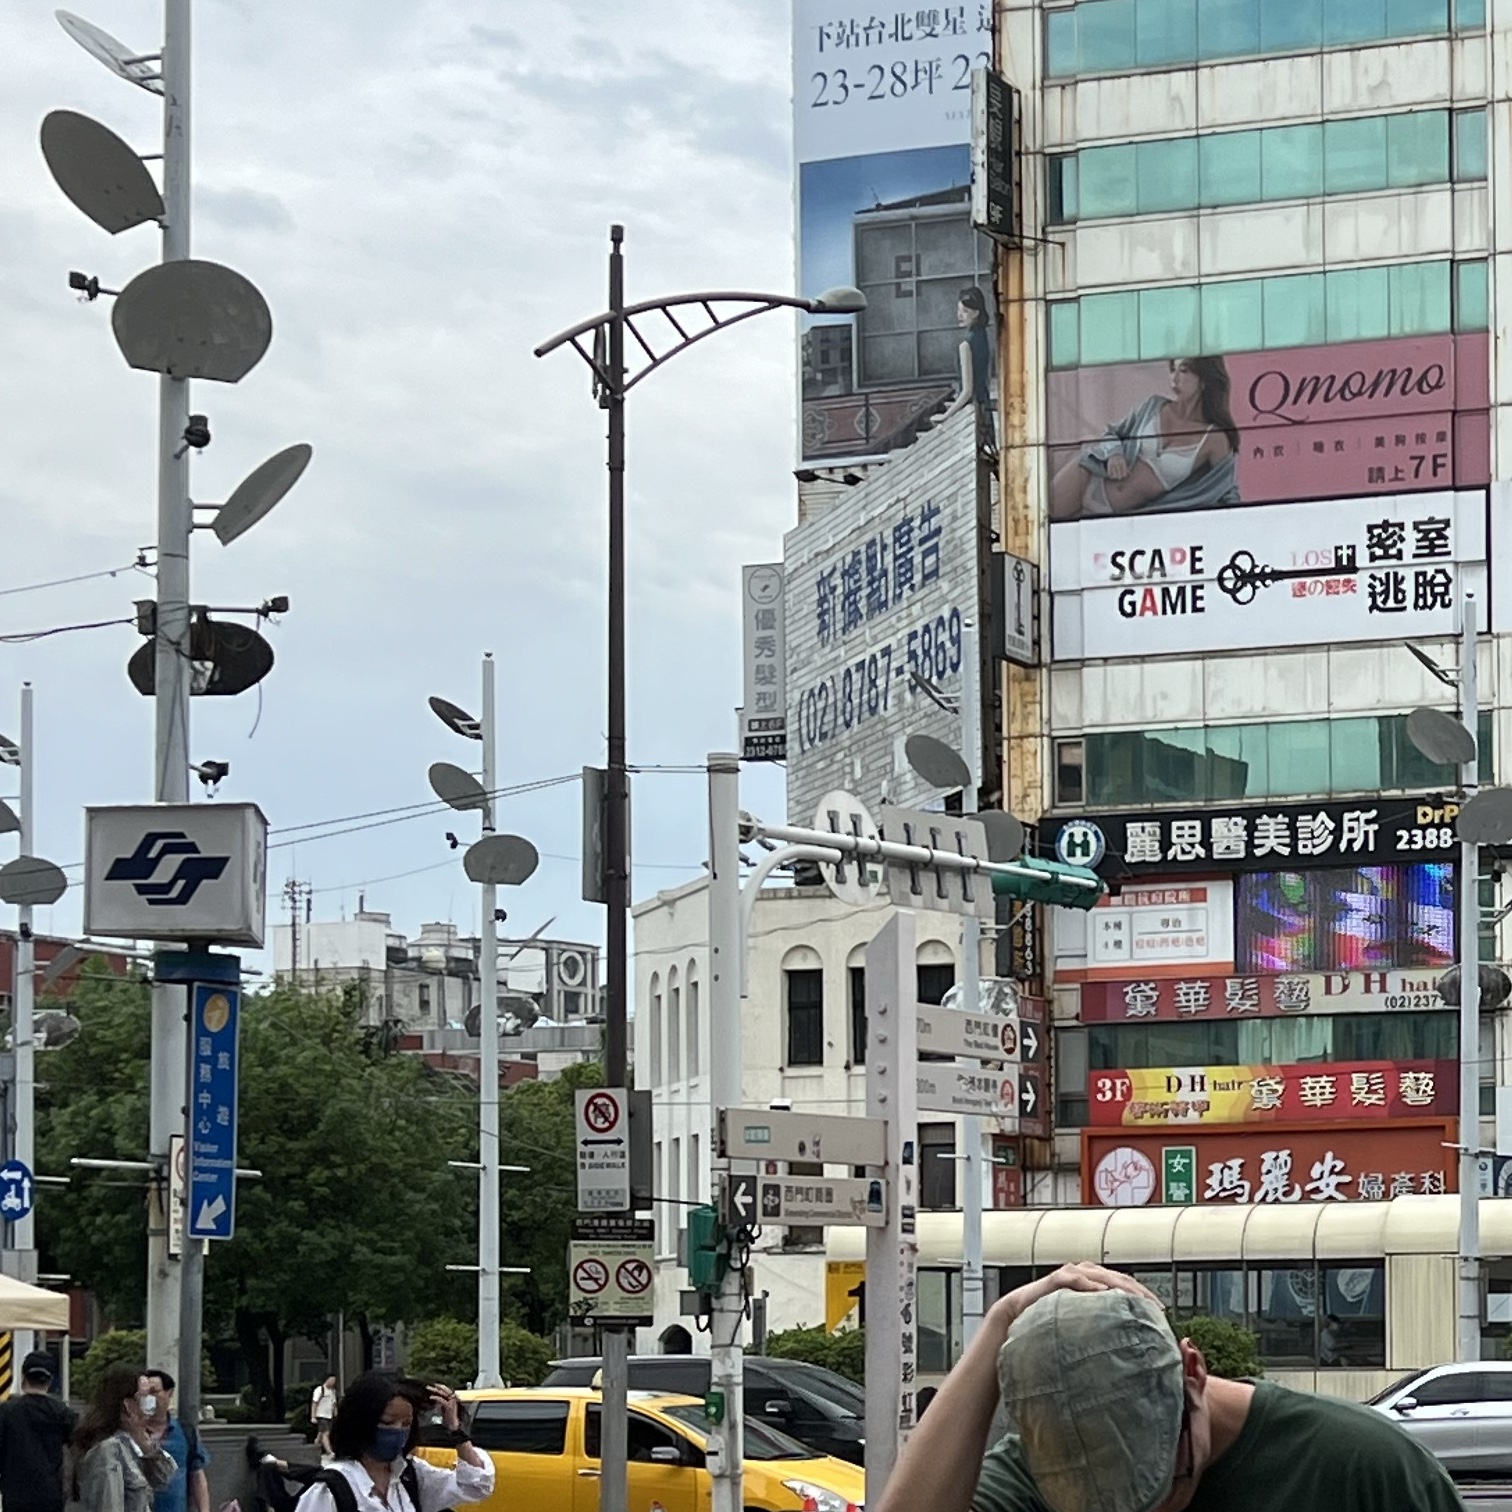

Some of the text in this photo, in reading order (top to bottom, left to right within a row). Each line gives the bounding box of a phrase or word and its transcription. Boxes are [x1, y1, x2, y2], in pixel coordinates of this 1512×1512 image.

[810, 5, 967, 53] 下站台北雙星
[811, 58, 943, 109] 23-28坪
[1249, 363, 1446, 424] Qmomo
[1366, 516, 1452, 563] 密室
[816, 500, 942, 648] 新據點廣告
[1118, 584, 1206, 618] GAME
[1124, 807, 1379, 864] 麗思醫美診所
[1400, 976, 1440, 993] hai
[1096, 1077, 1131, 1102] 3F
[1212, 1079, 1243, 1092] hair
[1203, 1150, 1354, 1205] 瑪麗安
